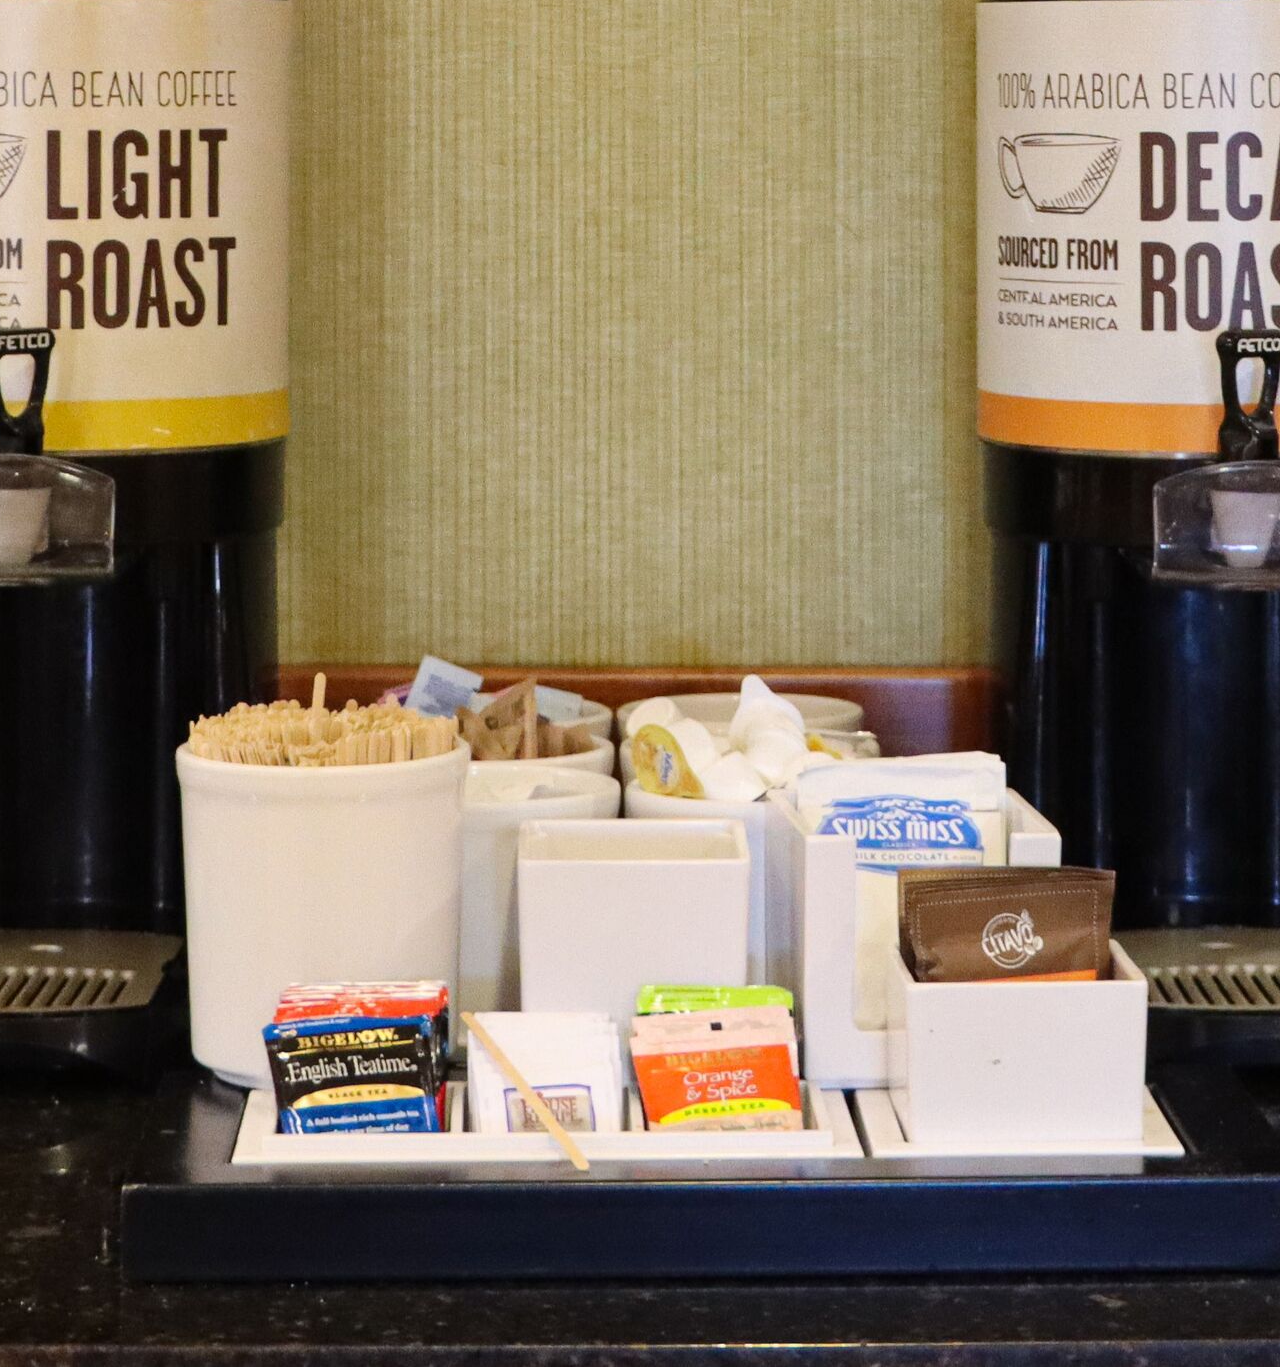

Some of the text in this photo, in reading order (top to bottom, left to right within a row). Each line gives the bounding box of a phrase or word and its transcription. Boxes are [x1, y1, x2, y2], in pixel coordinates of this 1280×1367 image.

[72, 70, 144, 108] BEAN
[157, 70, 238, 108] COFFEE
[997, 73, 1036, 109] 100%
[1042, 73, 1150, 110] ARABICA
[1163, 73, 1236, 109] BEAN
[46, 128, 228, 220] LIGHT
[998, 236, 1119, 271] SOURCED FROM
[46, 237, 236, 329] ROAST
[998, 289, 1118, 308] CENTRAL AMERICA
[998, 312, 1118, 331] & SOUTH AMERICA
[831, 815, 966, 845] SWISS MISS
[856, 852, 877, 862] ILK
[880, 852, 949, 862] CHOCOLATE
[981, 922, 1035, 958] CITAVO
[296, 1027, 397, 1051] BIGELOW
[288, 1052, 412, 1085] English Teatime
[682, 1067, 755, 1087] Orange
[368, 1087, 389, 1097] TEA
[685, 1082, 759, 1105] & Spice
[683, 1101, 766, 1118] HERBAL TEA
